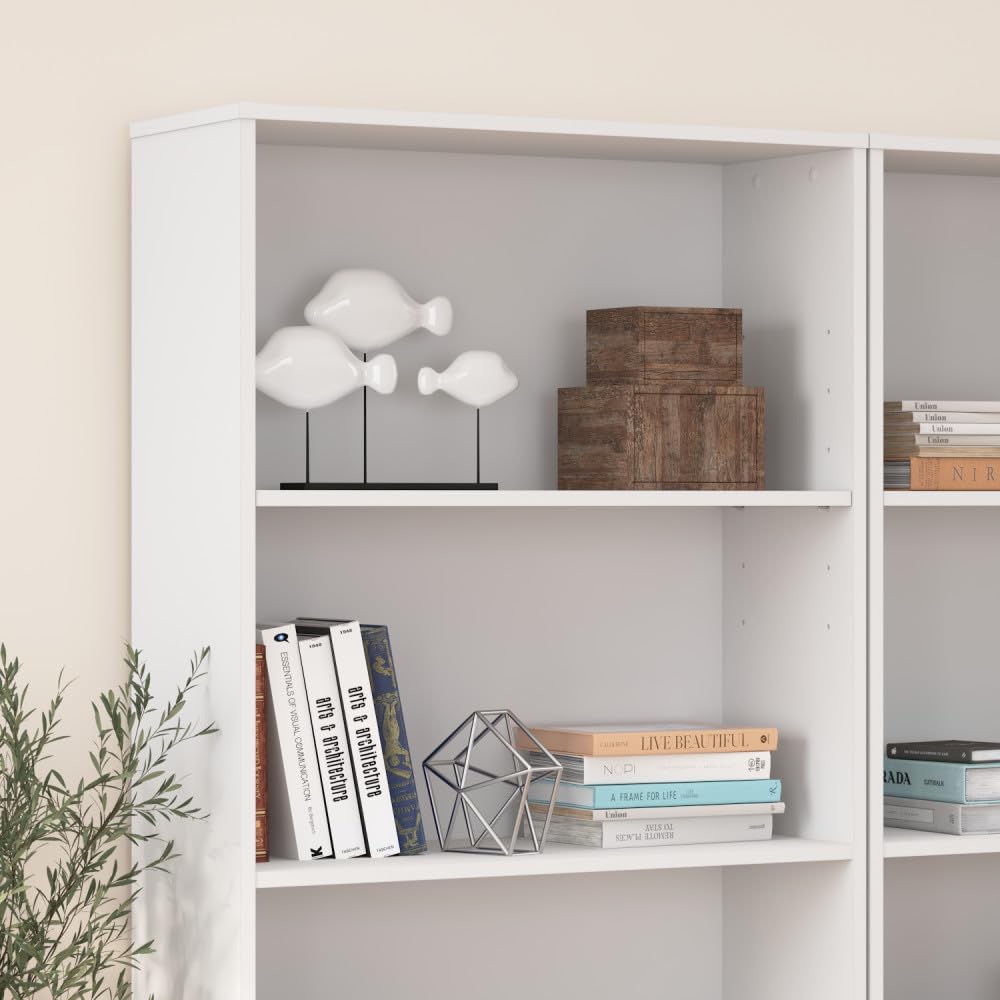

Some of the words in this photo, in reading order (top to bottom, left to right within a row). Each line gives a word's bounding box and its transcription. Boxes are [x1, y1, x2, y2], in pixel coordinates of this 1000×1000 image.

[925, 413, 947, 421] Union
[927, 436, 949, 444] Union
[280, 651, 295, 697] ESSENTIALS
[287, 698, 297, 711] OF
[316, 697, 336, 720] arts
[348, 686, 367, 710] arts
[289, 710, 302, 736] VISUAL
[641, 736, 671, 751] LIVE
[675, 733, 749, 750] BEAUTIFUL
[293, 737, 312, 802] COMMUNICATION
[322, 735, 349, 803] architecture
[355, 727, 382, 798] architecture
[610, 793, 616, 802] A
[619, 792, 643, 801] FRAME
[646, 791, 660, 800] FOR
[662, 790, 677, 800] LIFE
[605, 811, 628, 819] Union
